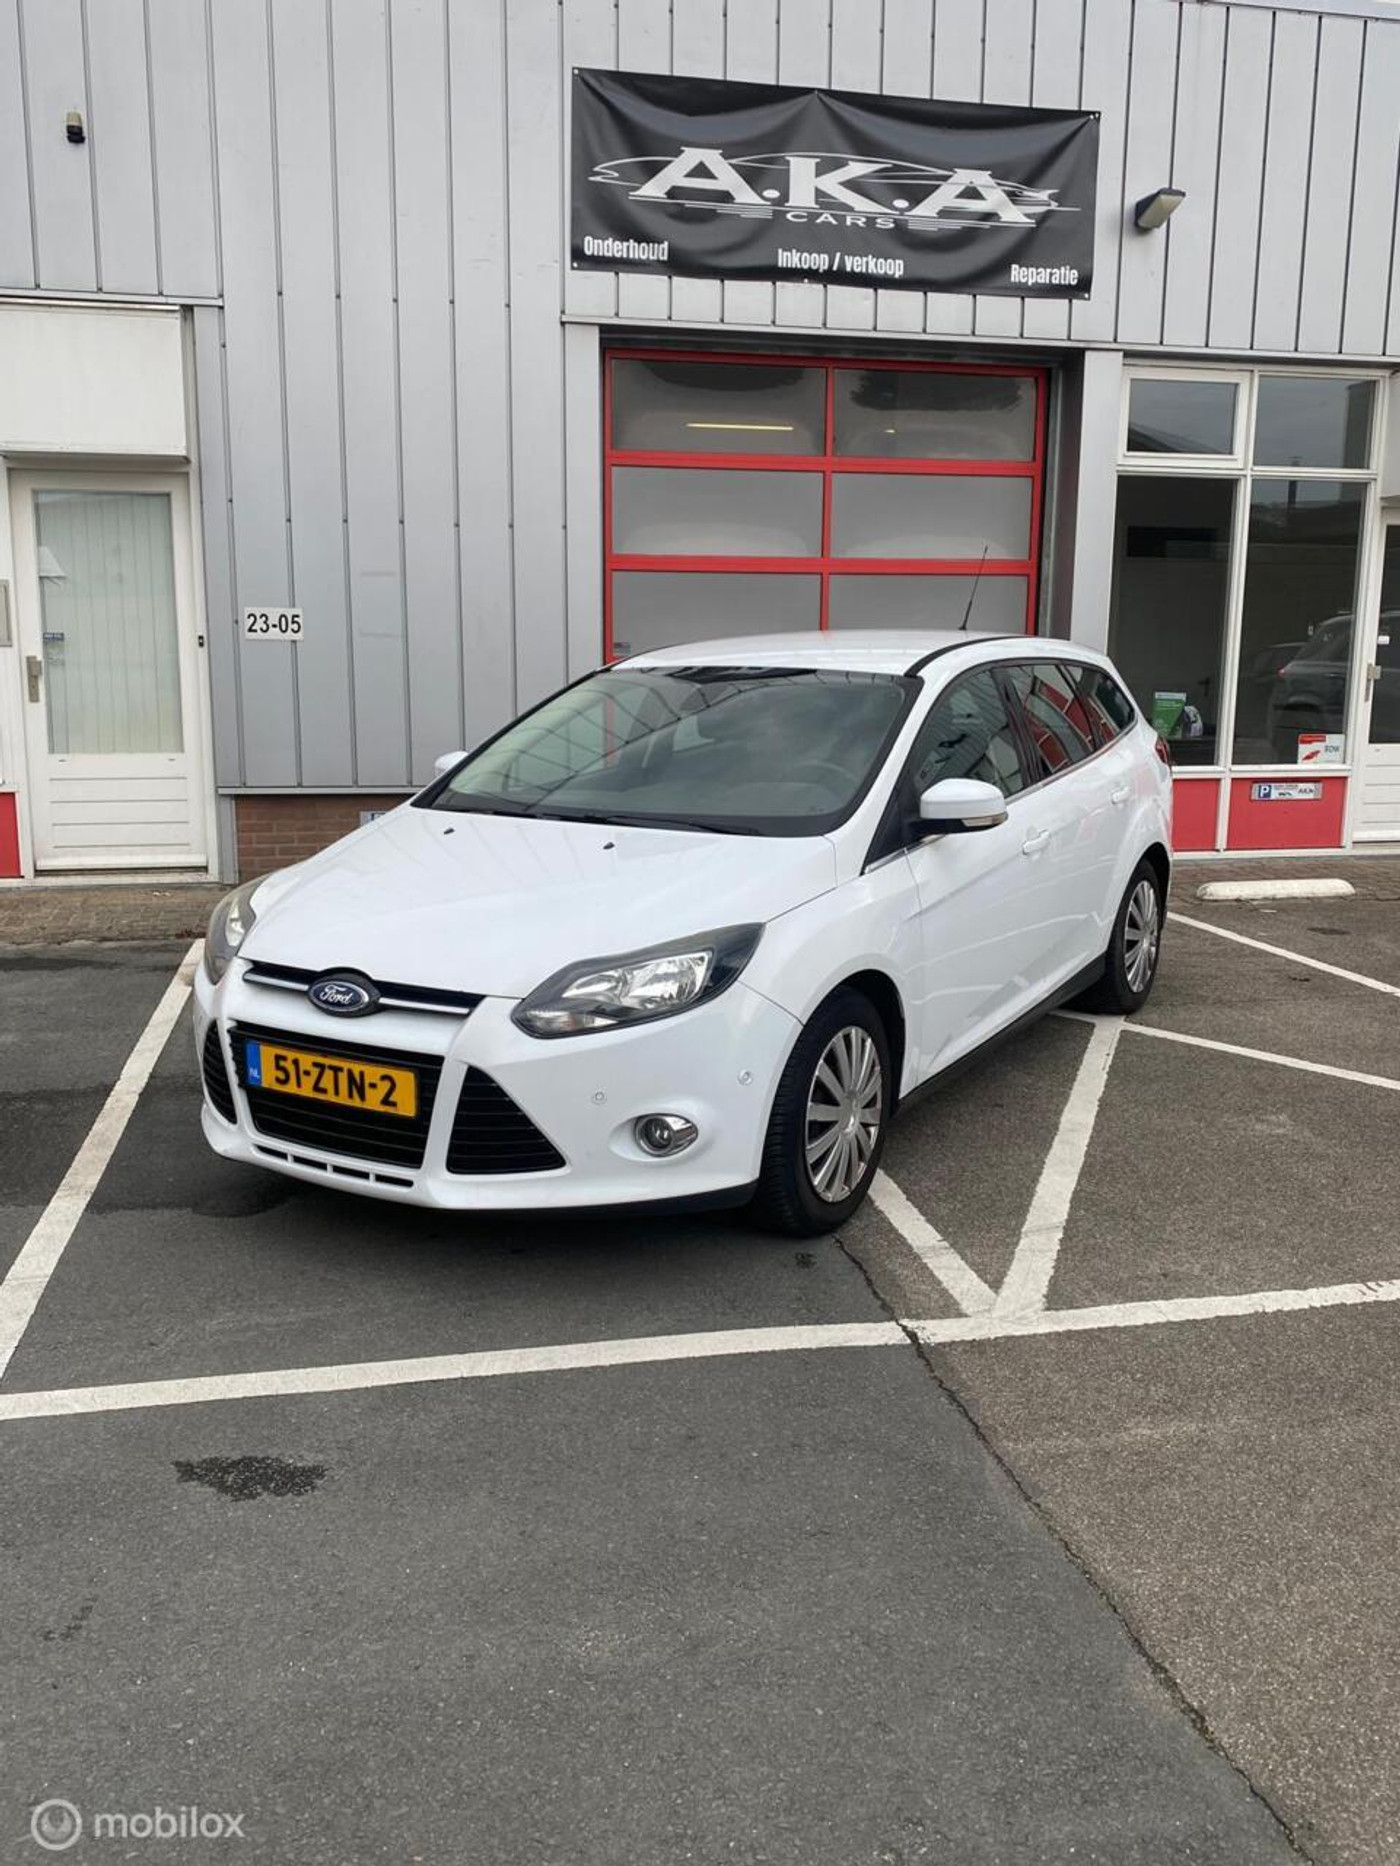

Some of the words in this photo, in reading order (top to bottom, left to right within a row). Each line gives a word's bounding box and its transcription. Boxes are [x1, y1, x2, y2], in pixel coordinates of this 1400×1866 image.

[786, 211, 895, 229] CARS
[583, 236, 669, 261] Onderhoud
[777, 247, 829, 272] Inkoop
[833, 253, 840, 270] /
[845, 256, 905, 278] verkoop
[1010, 263, 1079, 286] Reparatie
[247, 613, 301, 633] 23-05
[319, 984, 353, 1004] Ford
[249, 1067, 260, 1079] NL
[273, 1053, 398, 1108] 51-ZTN-2
